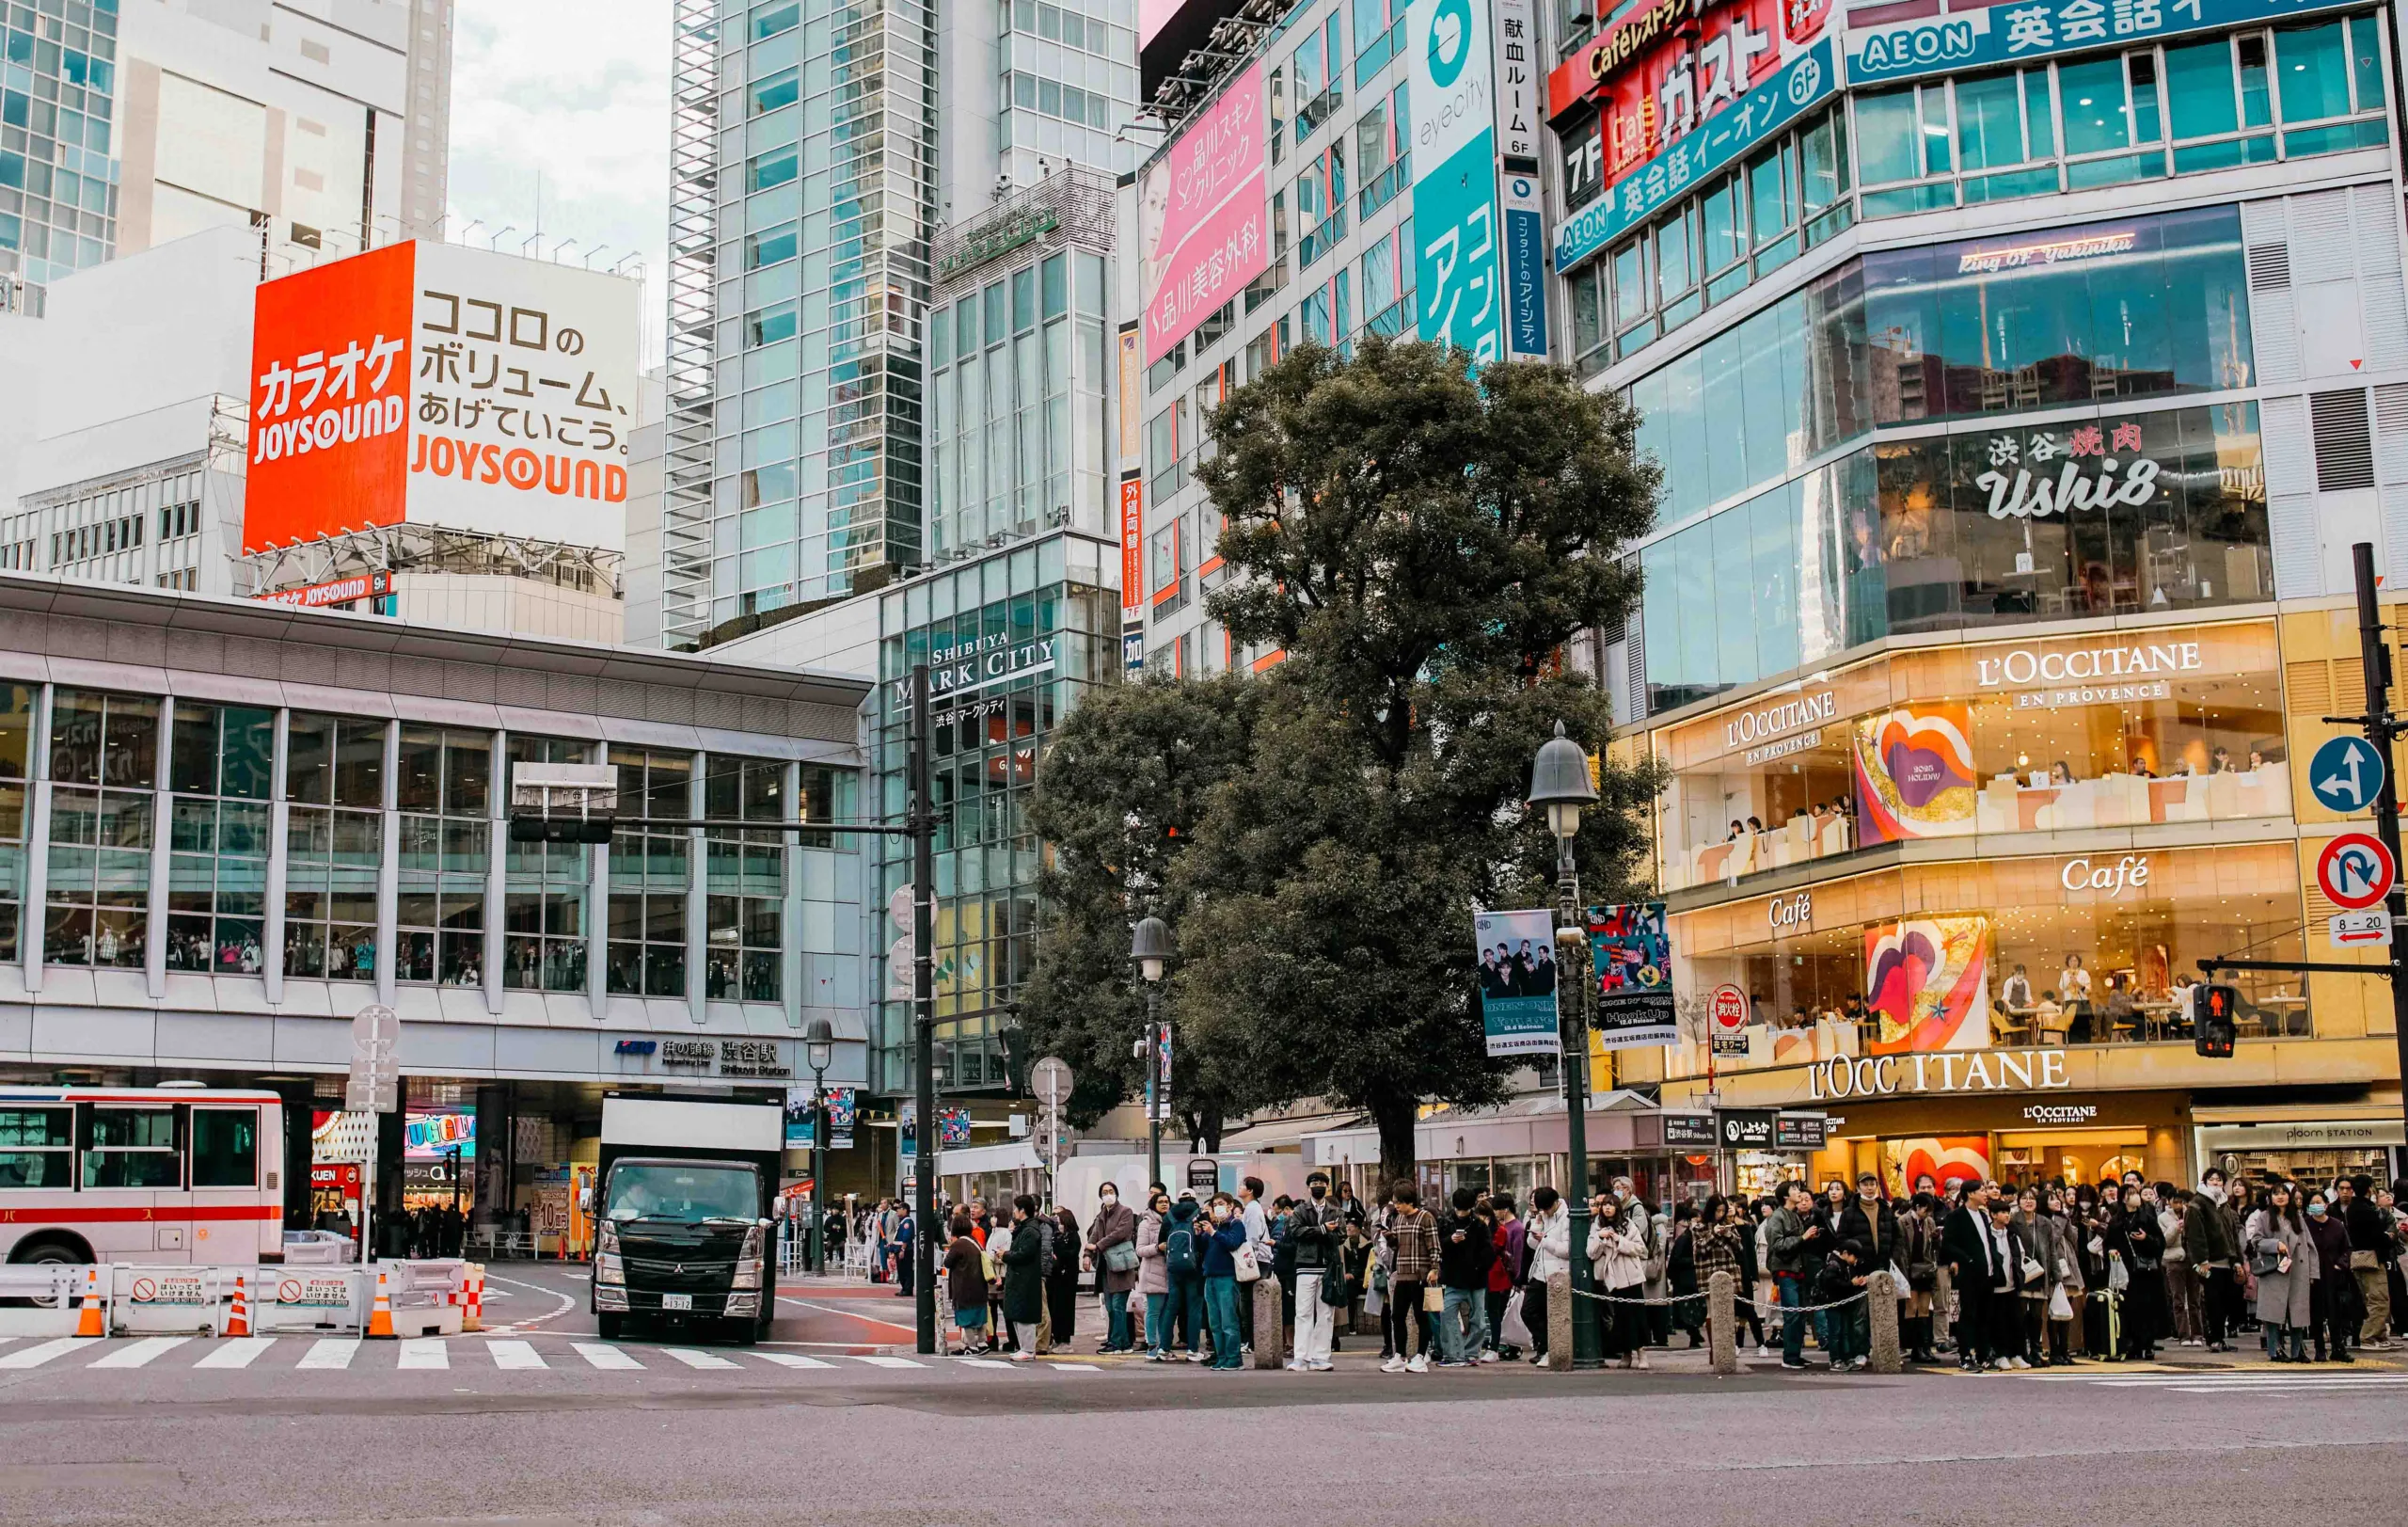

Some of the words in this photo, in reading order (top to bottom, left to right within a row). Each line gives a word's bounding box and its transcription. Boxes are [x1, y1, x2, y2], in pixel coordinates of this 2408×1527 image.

[1864, 24, 1972, 65] AEON
[1504, 18, 1529, 135] 献血ルーム
[1660, 19, 1768, 149] ガスト
[1420, 72, 1486, 147] eyecity
[1193, 93, 1256, 175] 品川スキン
[1512, 140, 1529, 154] 6F
[1195, 134, 1250, 210] クリニック
[1567, 133, 1601, 194] 7F
[1623, 91, 1779, 222] 英会話イーオン
[1509, 198, 1535, 209] eyecity
[1561, 202, 1607, 259] AEON
[1162, 214, 1260, 335] 品川美容外科
[1518, 215, 1535, 348] コンタクトのアイシティ
[421, 289, 585, 357] ココロの
[257, 333, 404, 422] カラオケ
[420, 341, 628, 416] ボリューム、
[254, 394, 404, 466] JOYSOUND
[418, 391, 628, 456] あげていこう。
[410, 433, 627, 503] JOYSOUND
[1975, 458, 2160, 520] Ushi8
[1125, 483, 1138, 550] 外貨両替
[305, 578, 366, 606] JOYSOUND
[373, 576, 386, 590] 9F
[1128, 606, 1140, 619] 7F
[932, 631, 1008, 665] SHIBUYA
[988, 639, 1055, 676] CITY
[1977, 643, 2202, 687] L'OCCITANE
[2020, 694, 2044, 708] EN
[2056, 684, 2163, 705] PROVENCE
[1727, 691, 1836, 748] L'OCCITANE
[1748, 750, 1761, 763] EN
[1765, 733, 1817, 758] PROVENCE
[1908, 772, 1941, 782] HOLIDAY
[1912, 764, 1935, 773] 2025
[2061, 855, 2148, 898] Café
[1767, 893, 1811, 932] Café
[2338, 919, 2347, 931] 8
[2366, 916, 2382, 929] 20
[1607, 1009, 1647, 1024] Hook
[1647, 1008, 1670, 1021] Up
[1718, 1002, 1740, 1017] 消火栓
[663, 1041, 715, 1058] 井の頭線
[721, 1041, 778, 1062] 渋谷駅
[720, 1064, 756, 1075] Shibuya
[758, 1065, 792, 1076] Station
[2023, 1105, 2098, 1119] L'OCCITANE
[1674, 1128, 1693, 1138] 渋谷駅
[2327, 1129, 2372, 1137] STATION
[4, 1210, 16, 1222] バ
[142, 1208, 154, 1220] ス
